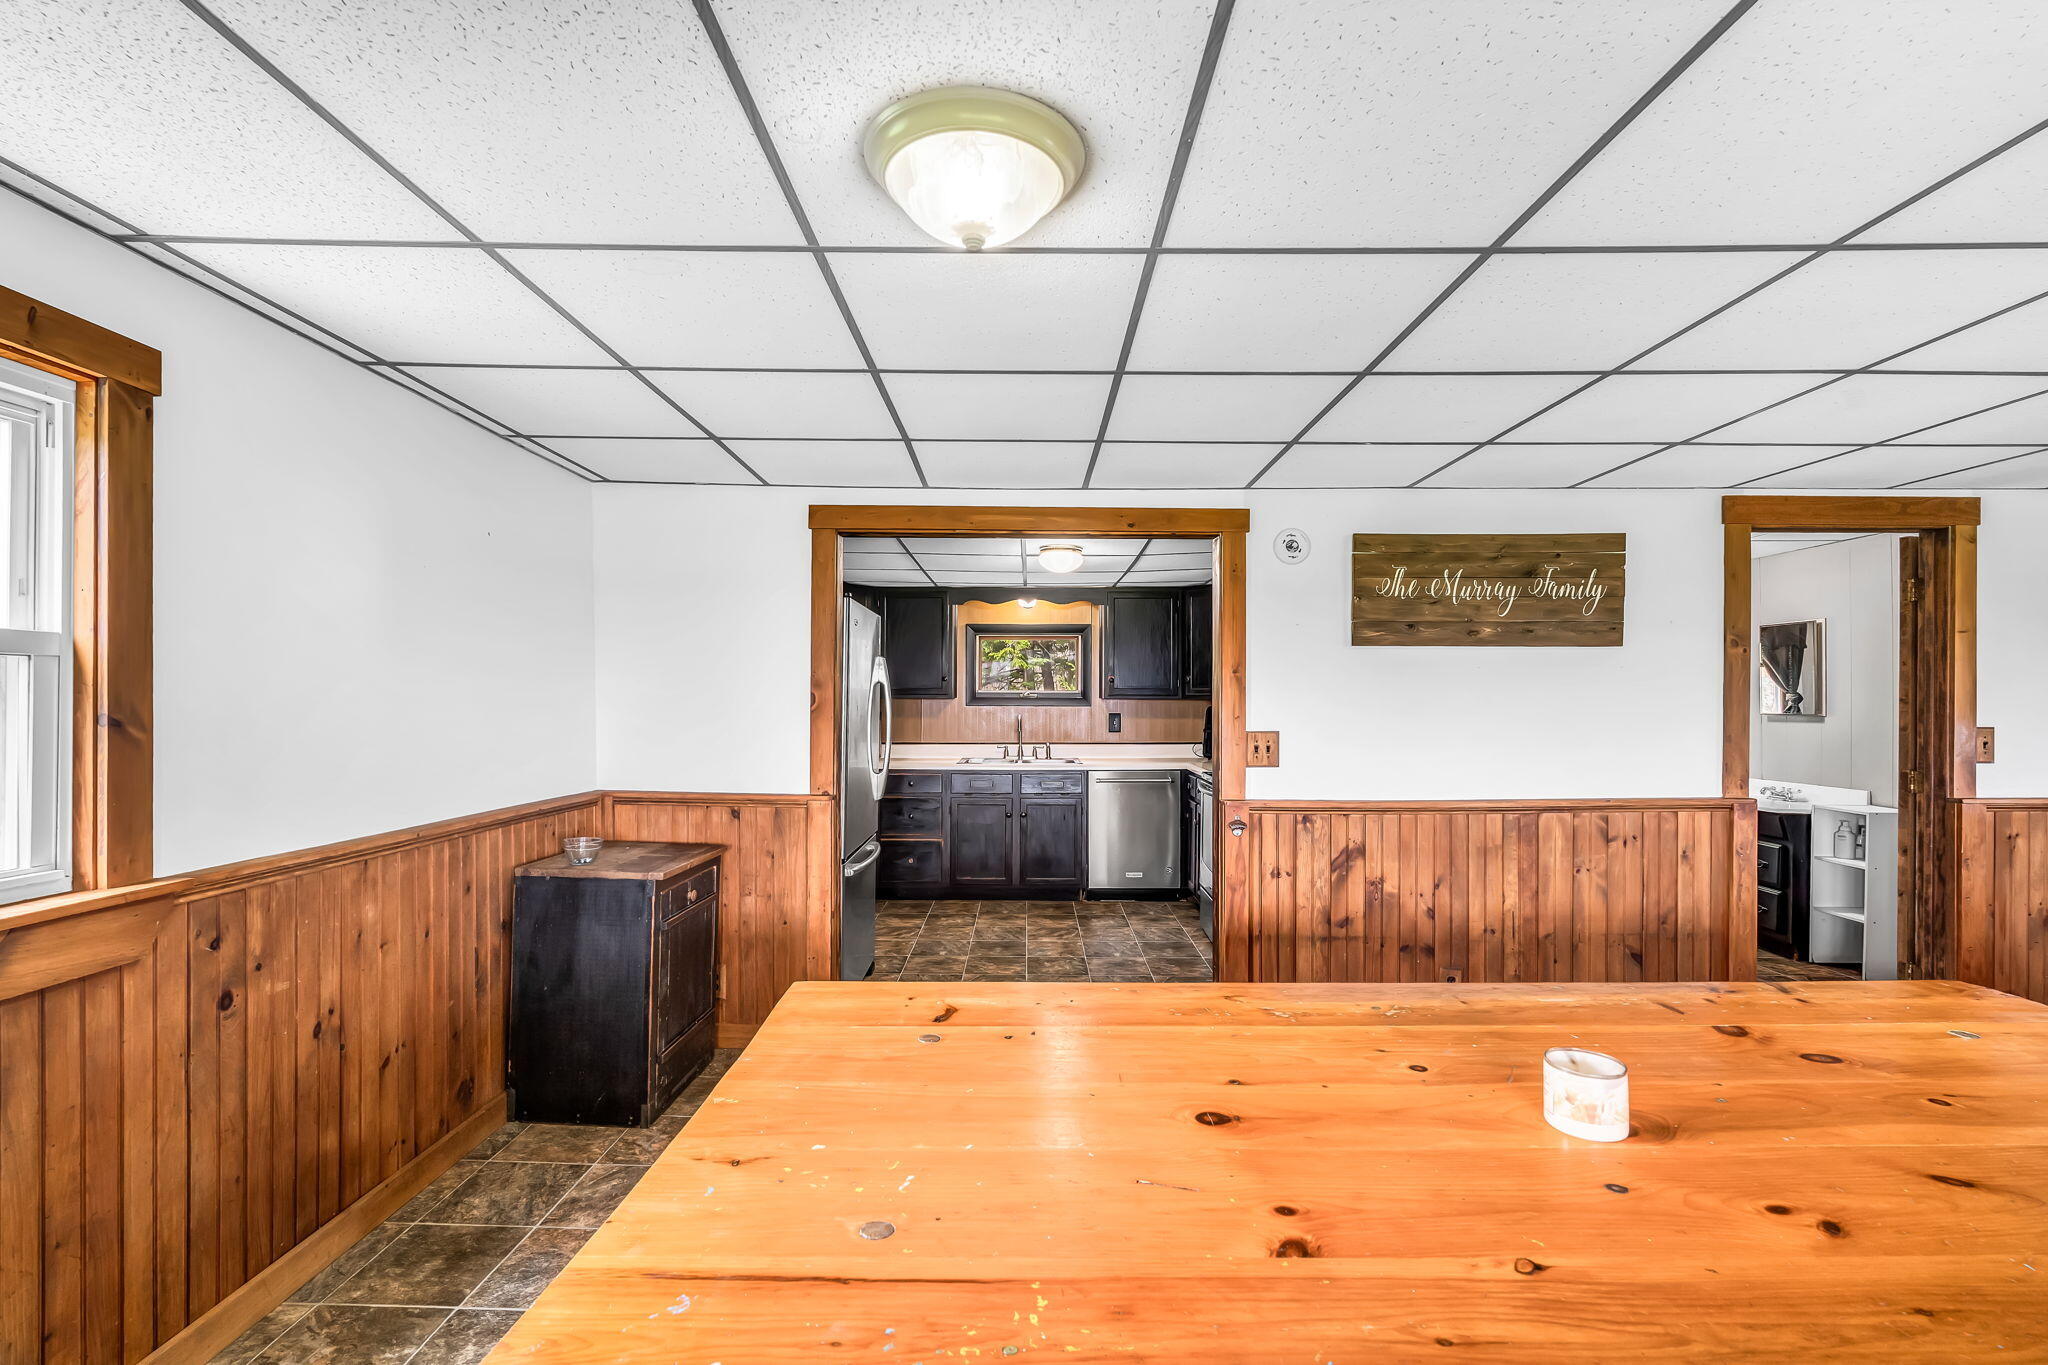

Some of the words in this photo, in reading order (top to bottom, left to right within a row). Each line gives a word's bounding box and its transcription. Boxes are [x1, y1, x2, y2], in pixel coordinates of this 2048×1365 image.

[1375, 564, 1420, 600] The
[1425, 568, 1522, 617] Murray
[1528, 564, 1607, 616] Family
